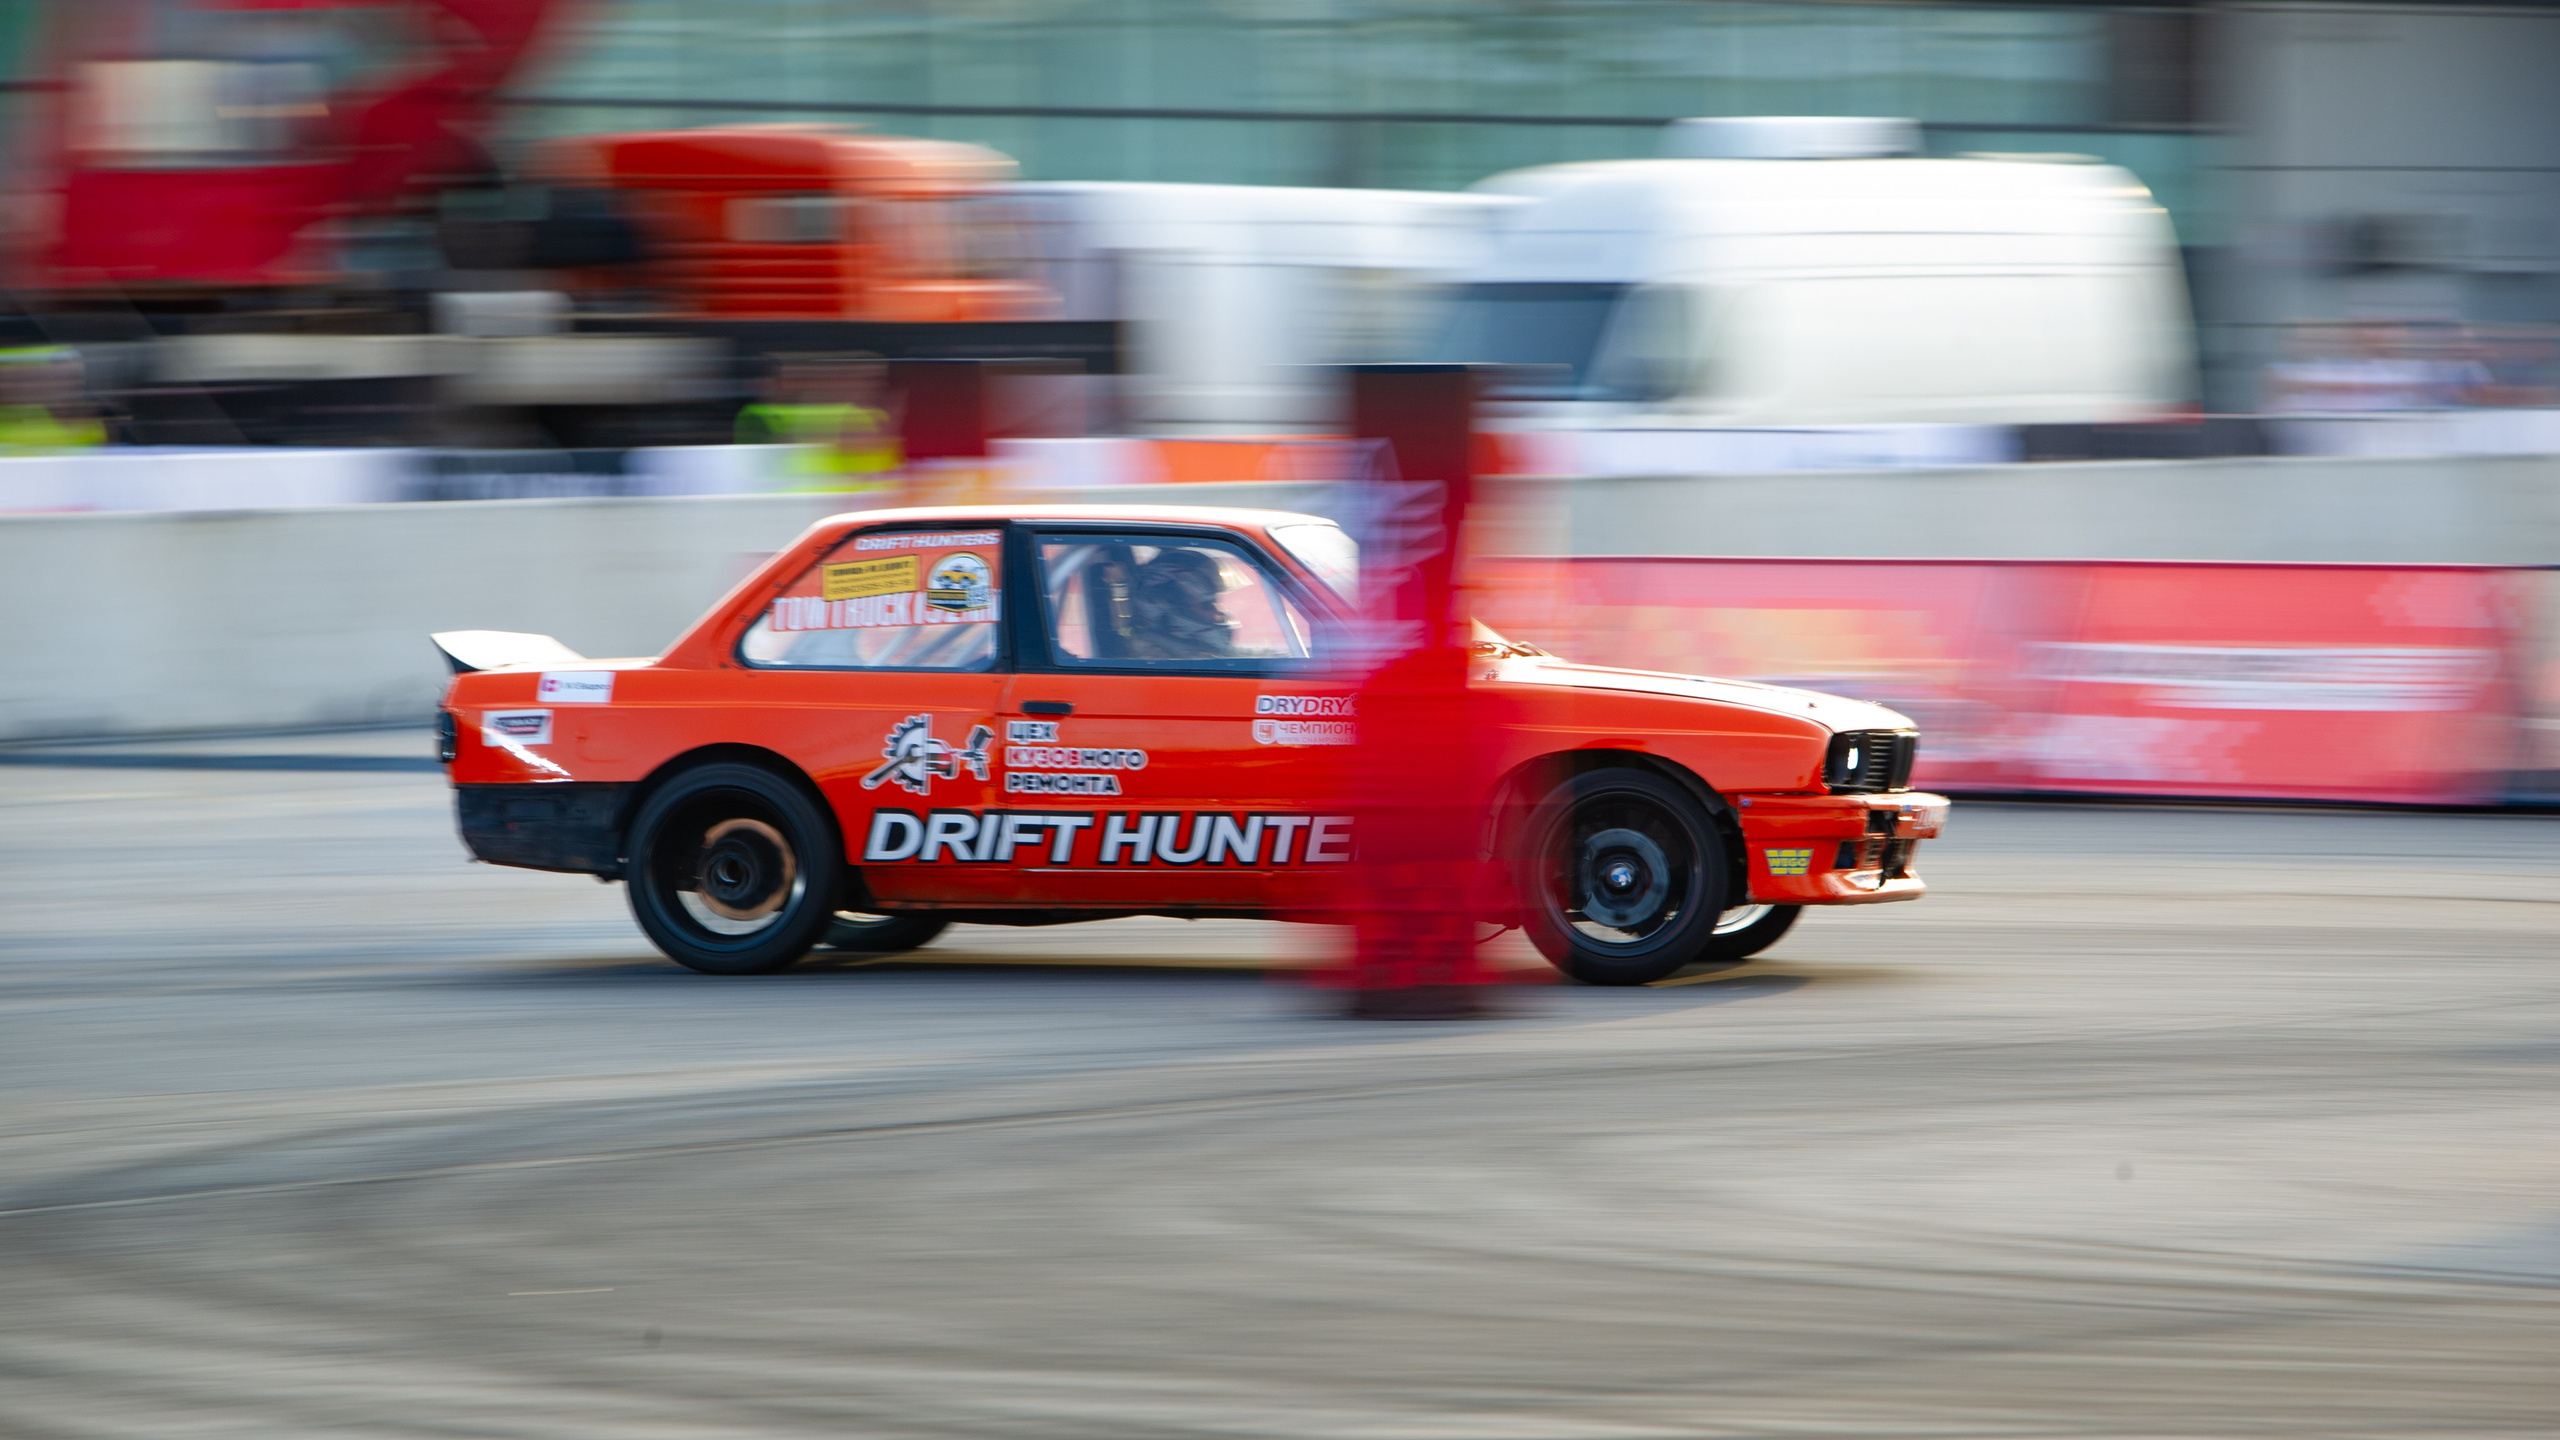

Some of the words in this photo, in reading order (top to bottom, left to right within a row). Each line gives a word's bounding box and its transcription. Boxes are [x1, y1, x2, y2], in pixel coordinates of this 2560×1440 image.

[855, 536, 913, 551] DRIFT
[911, 533, 1001, 549] HUNTERS
[1008, 722, 1057, 742] ЦЕХ
[1280, 723, 1358, 735] ЧЕМПИОН
[1008, 748, 1146, 768] КУЗОВНОГО
[1008, 774, 1120, 793] РЕМОНТА
[863, 810, 1094, 863] DRIFT
[1099, 812, 1358, 865] HUNTE
